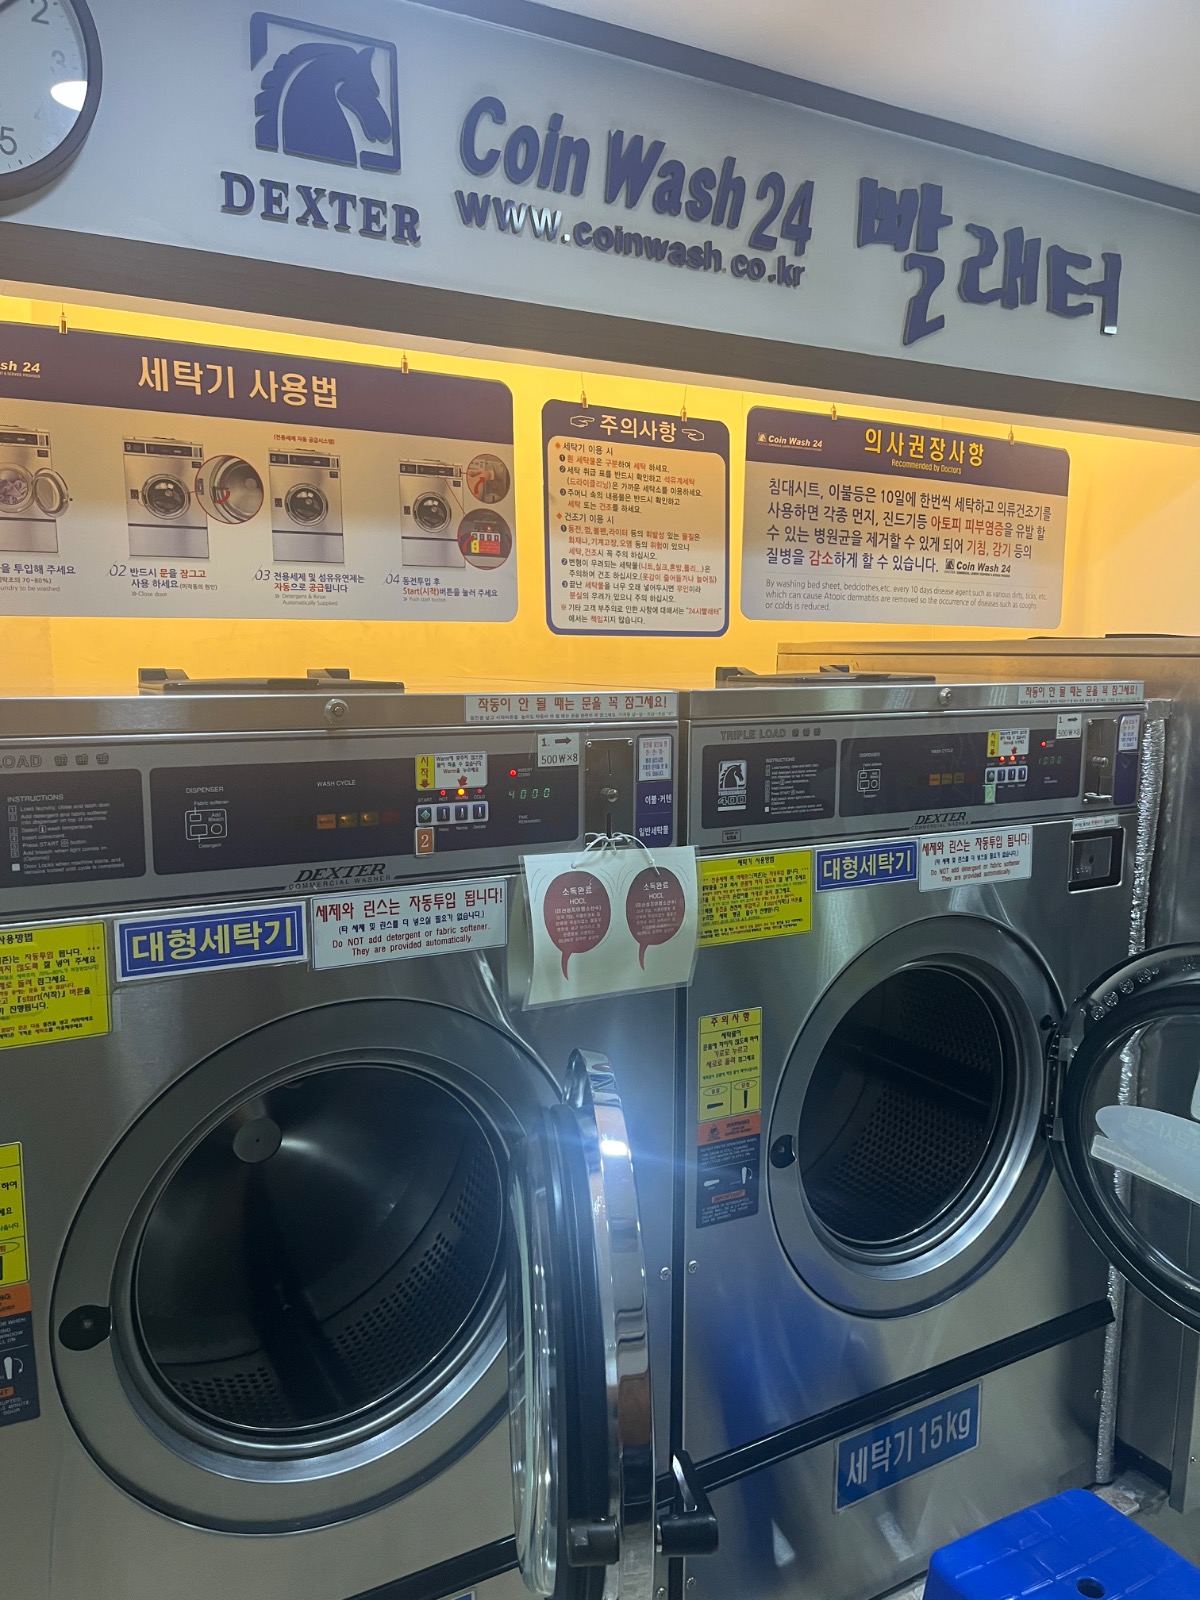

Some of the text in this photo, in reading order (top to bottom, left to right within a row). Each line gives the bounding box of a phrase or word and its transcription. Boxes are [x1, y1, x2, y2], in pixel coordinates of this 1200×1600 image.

[460, 97, 816, 256] Coin Wash 24
[220, 171, 422, 246] DEXTER
[455, 190, 805, 288] www.coinwash.co.kr
[857, 176, 1122, 346] 빨래터
[22, 362, 41, 373] 24
[138, 356, 338, 409] 세탁기 사용법
[600, 414, 677, 443] 주의사항
[563, 442, 614, 456] 세탁기 이용 시
[768, 435, 788, 446] Coin
[789, 437, 812, 448] Wash
[812, 440, 824, 449] 24
[864, 427, 985, 468] 의사권장사항
[567, 455, 670, 473] 흰 세탁물은 구분하여 세탁 하세요.
[891, 459, 962, 475] Recommended by Doctors
[567, 466, 581, 475] 세탁
[583, 467, 596, 477] 취급
[614, 470, 634, 481] 반드시
[636, 471, 662, 483] 확인하고
[567, 488, 587, 498] 주머니
[590, 490, 603, 500] 속의
[633, 493, 653, 504] 반드시
[655, 495, 681, 506] 확인하고
[768, 478, 1052, 523] 침대시트, 이불등은 10일에 한번씩 세탁하고 의류건조기를
[567, 500, 642, 514] 세탁 또는 건조를 하세요.
[564, 512, 614, 525] 건조기 이용 시
[767, 501, 1046, 542] 사용하면 각종 먼지, 진드기등 아토피 피부염증을 유발 할
[766, 524, 1032, 561] 수 있는 병원균을 제거할 수 있게 되어 기침, 감기 등의
[766, 547, 939, 574] 질병을 감소하게 할 수 있습니다.
[956, 560, 1011, 574] Coin Wash 24
[13, 563, 76, 575] 투입해 주세요
[108, 565, 127, 577] 02
[130, 567, 207, 579] 반드시 문을 잠그고
[254, 569, 271, 581] 03
[131, 579, 179, 589] 사용 하세요
[273, 571, 365, 584] 전용세제 및 섬유유연제는
[385, 573, 400, 585] 04
[402, 576, 441, 586] 동전투입 후
[274, 582, 348, 593] 자동으로 공급됩니다
[462, 589, 476, 597] 눌러
[478, 589, 499, 598] 주세요
[478, 696, 511, 712] 작동이
[518, 696, 530, 711] 안
[554, 696, 575, 711] 때는
[581, 695, 602, 711] 문을
[608, 695, 619, 710] 꼭
[624, 694, 667, 711] 잠그세요!
[720, 728, 787, 741] TRIPLE LOAD
[185, 786, 224, 794] DISPENSER
[317, 779, 356, 788] WASH CYCLE
[7, 794, 64, 803] INSTRUCTIONS
[508, 787, 551, 800] 4000
[718, 794, 747, 806] 400
[914, 811, 967, 825] DEXTER
[638, 824, 670, 837] 일반세탁물
[420, 833, 430, 849] 2
[922, 832, 1030, 857] 세제와 린스는 자동투입 됩니다!
[823, 849, 911, 881] 대형세탁기
[292, 863, 386, 883] DEXTER
[287, 874, 391, 891] COMMERCIAL WASHER
[643, 881, 669, 891] 소독완료
[562, 886, 593, 897] 소독완료
[316, 887, 503, 923] 세제와 린스는 자동투입 됩니다!
[569, 898, 587, 906] HOCL
[132, 917, 293, 962] 대형세탁기
[332, 922, 491, 949] Do NOT add detergent or fabric softener.
[352, 934, 472, 959] They are provided automatically.
[24, 948, 83, 962] 자동투입 됩니다.
[846, 1406, 971, 1488] 세탁기 15kg
